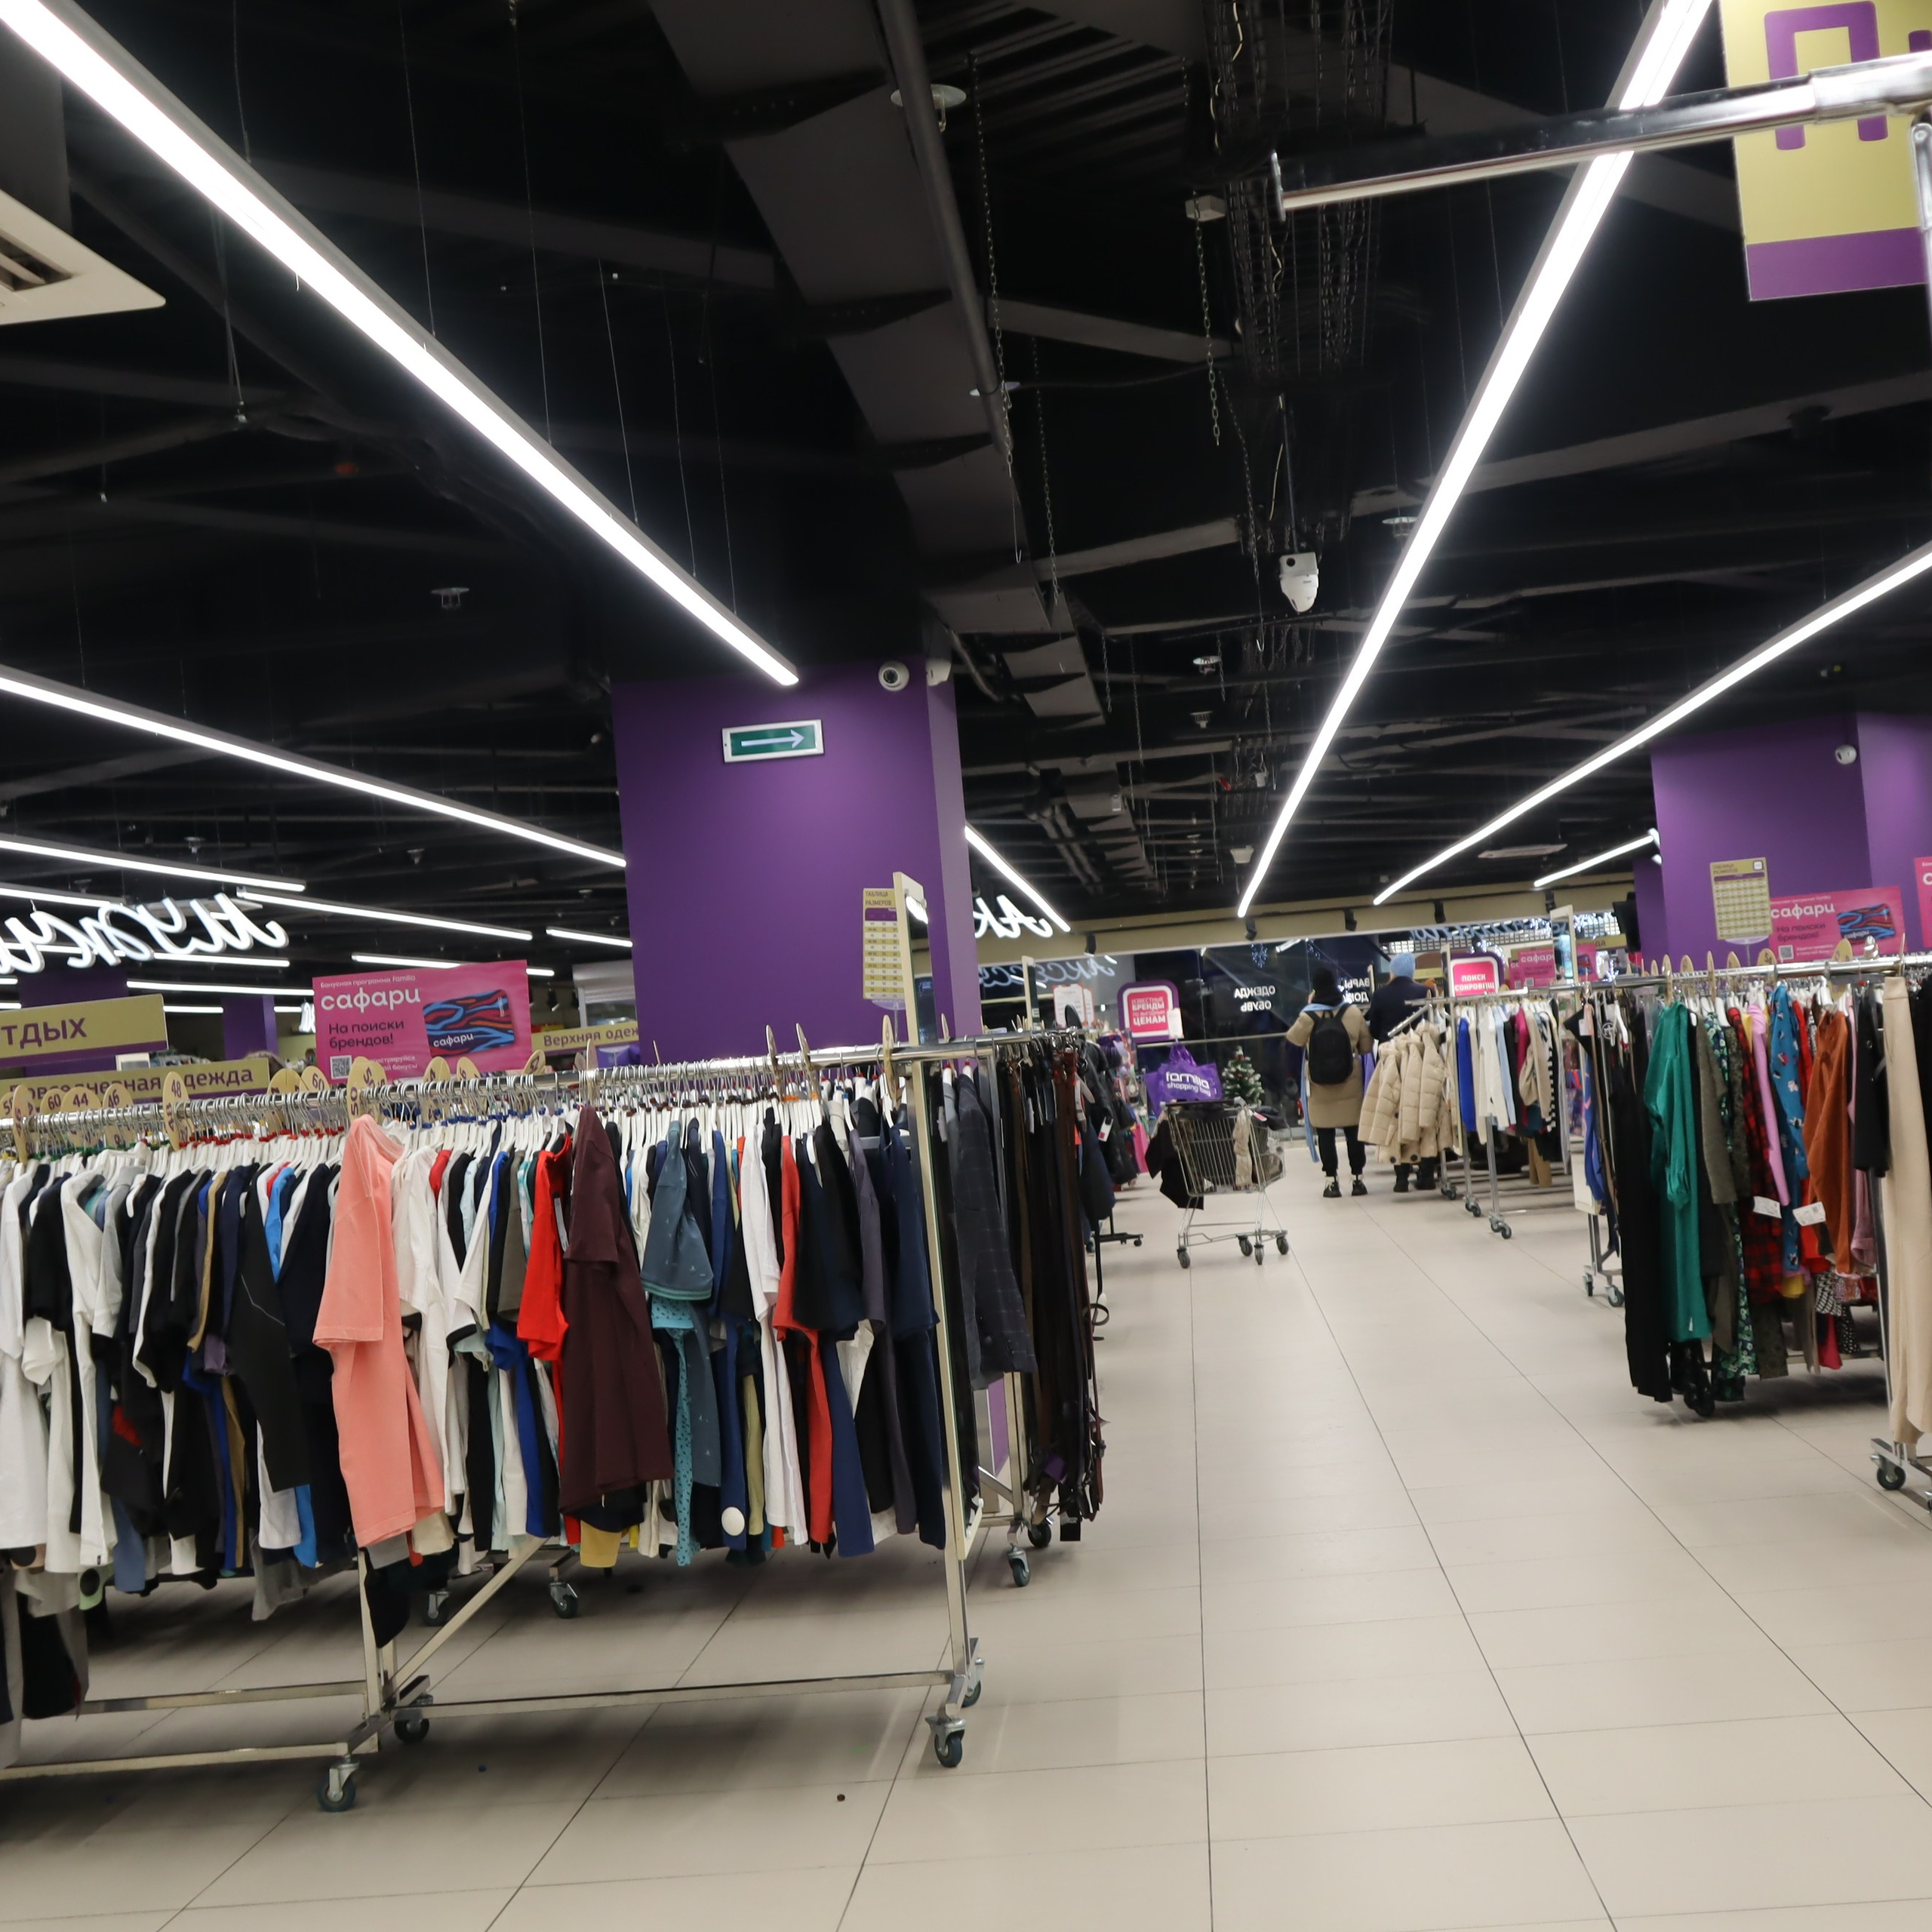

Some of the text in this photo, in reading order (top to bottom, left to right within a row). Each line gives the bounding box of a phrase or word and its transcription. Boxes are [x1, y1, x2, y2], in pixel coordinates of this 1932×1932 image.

[1771, 903, 1835, 920] сафари
[352, 978, 391, 987] программа
[1461, 974, 1487, 983] ПОИСК
[320, 987, 421, 1014] сафари
[1132, 1001, 1164, 1011] БРЕНДЫ
[328, 1020, 405, 1035] На поиски
[1134, 1015, 1166, 1026] ЦЕНАМ
[329, 1033, 394, 1051] брендов!
[432, 1032, 475, 1048] сафари
[543, 1029, 601, 1048] Верхняя
[183, 1068, 254, 1090] дежда
[1166, 1070, 1211, 1090] familia
[1167, 1081, 1200, 1094] shopping
[171, 1079, 182, 1098] 48
[48, 1094, 62, 1111] 60
[72, 1092, 89, 1108] 44
[108, 1088, 120, 1109] 46
[350, 1087, 359, 1116] 50
